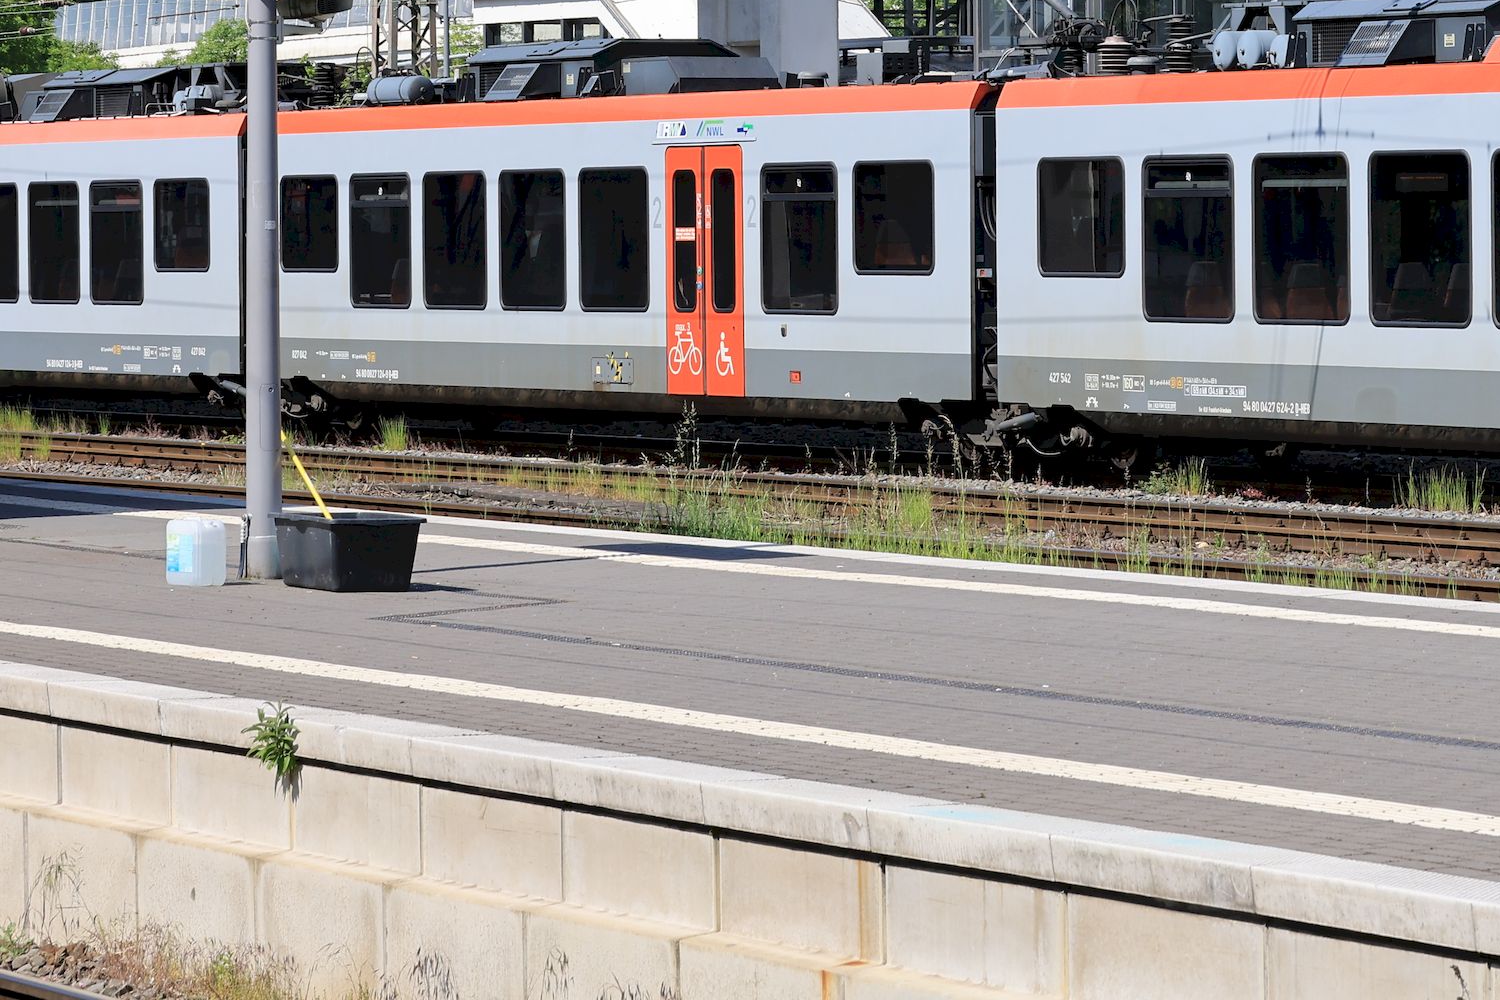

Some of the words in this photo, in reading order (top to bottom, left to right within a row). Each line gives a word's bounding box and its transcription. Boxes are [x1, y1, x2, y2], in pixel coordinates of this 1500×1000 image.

[706, 126, 724, 137] NWL
[653, 196, 662, 229] 2
[746, 195, 757, 228] 2
[1049, 372, 1060, 383] 427
[1060, 372, 1071, 384] 542
[1242, 400, 1251, 412] 94
[1251, 400, 1260, 412] 80
[1260, 401, 1275, 413] 0427
[1276, 402, 1294, 414] 624-2
